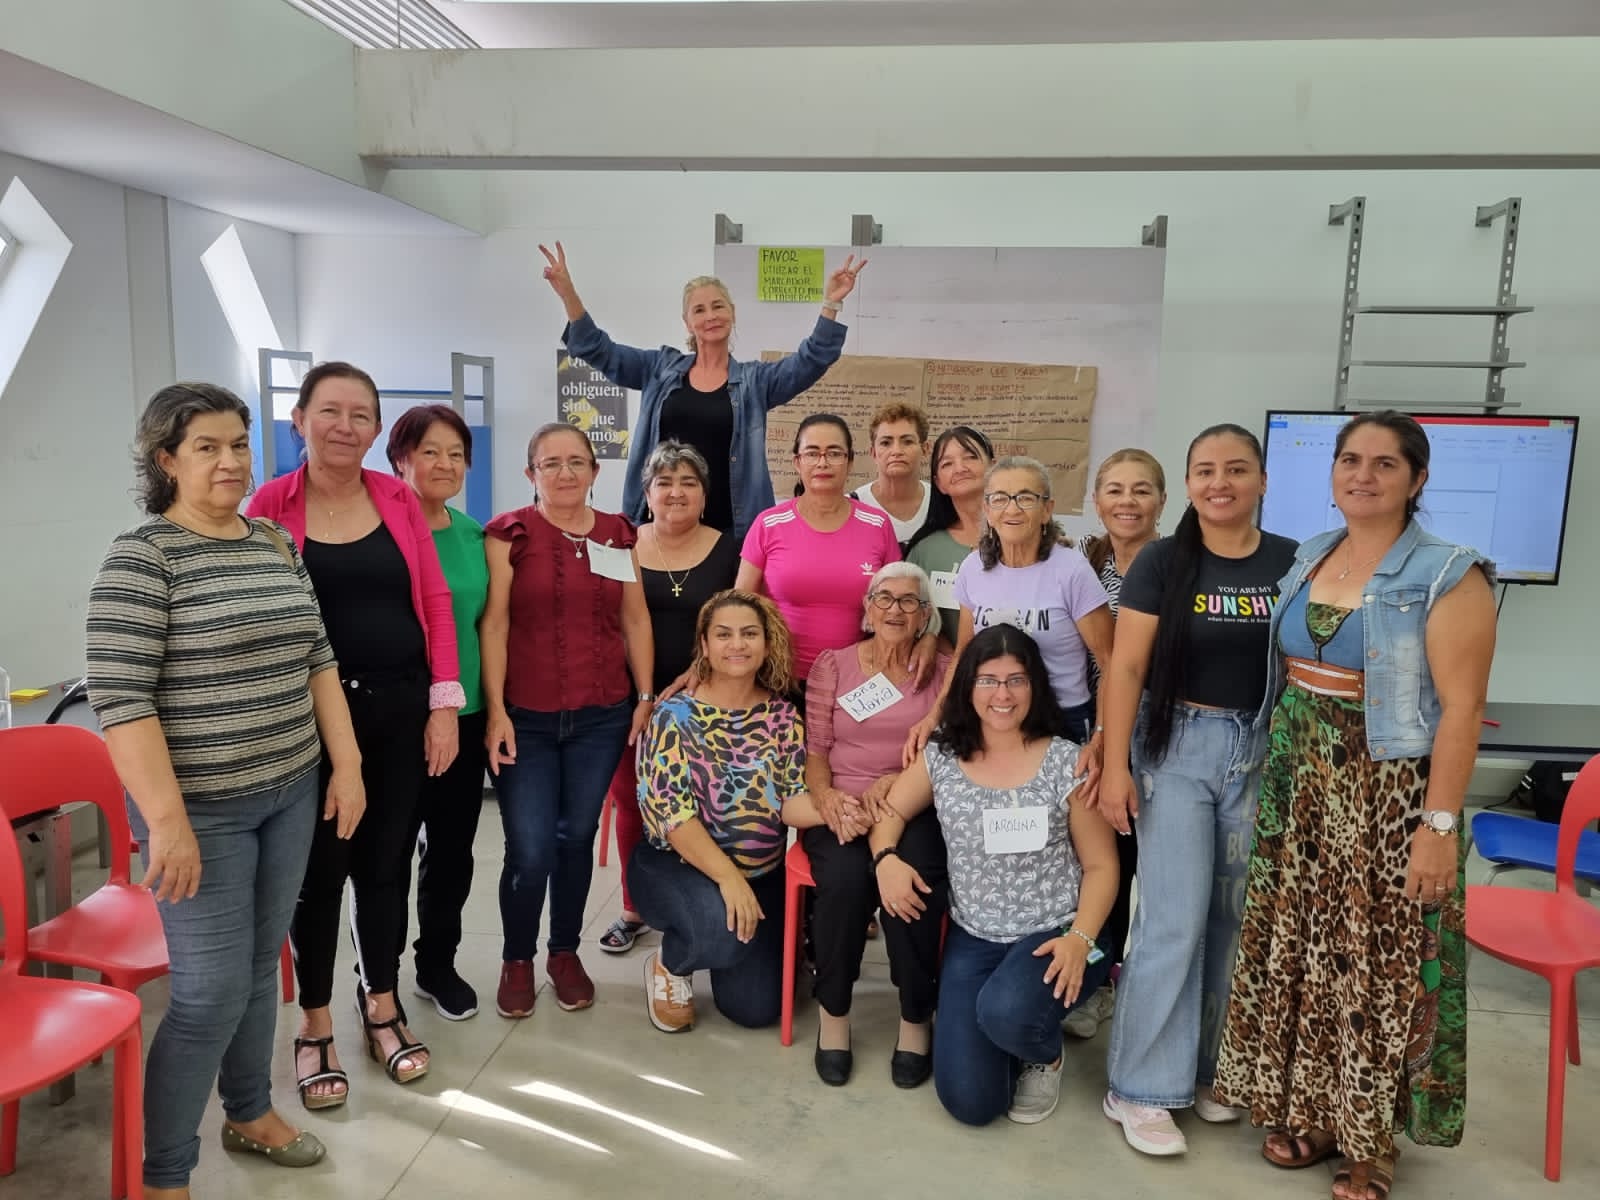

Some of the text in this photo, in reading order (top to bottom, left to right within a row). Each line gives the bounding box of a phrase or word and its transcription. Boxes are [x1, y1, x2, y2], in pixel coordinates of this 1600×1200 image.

[763, 249, 798, 262] FAVOR
[561, 381, 625, 400] obliguen,
[562, 398, 592, 413] sino
[591, 413, 615, 428] que
[1218, 585, 1237, 593] YOU
[1193, 594, 1279, 616] SUNSHI
